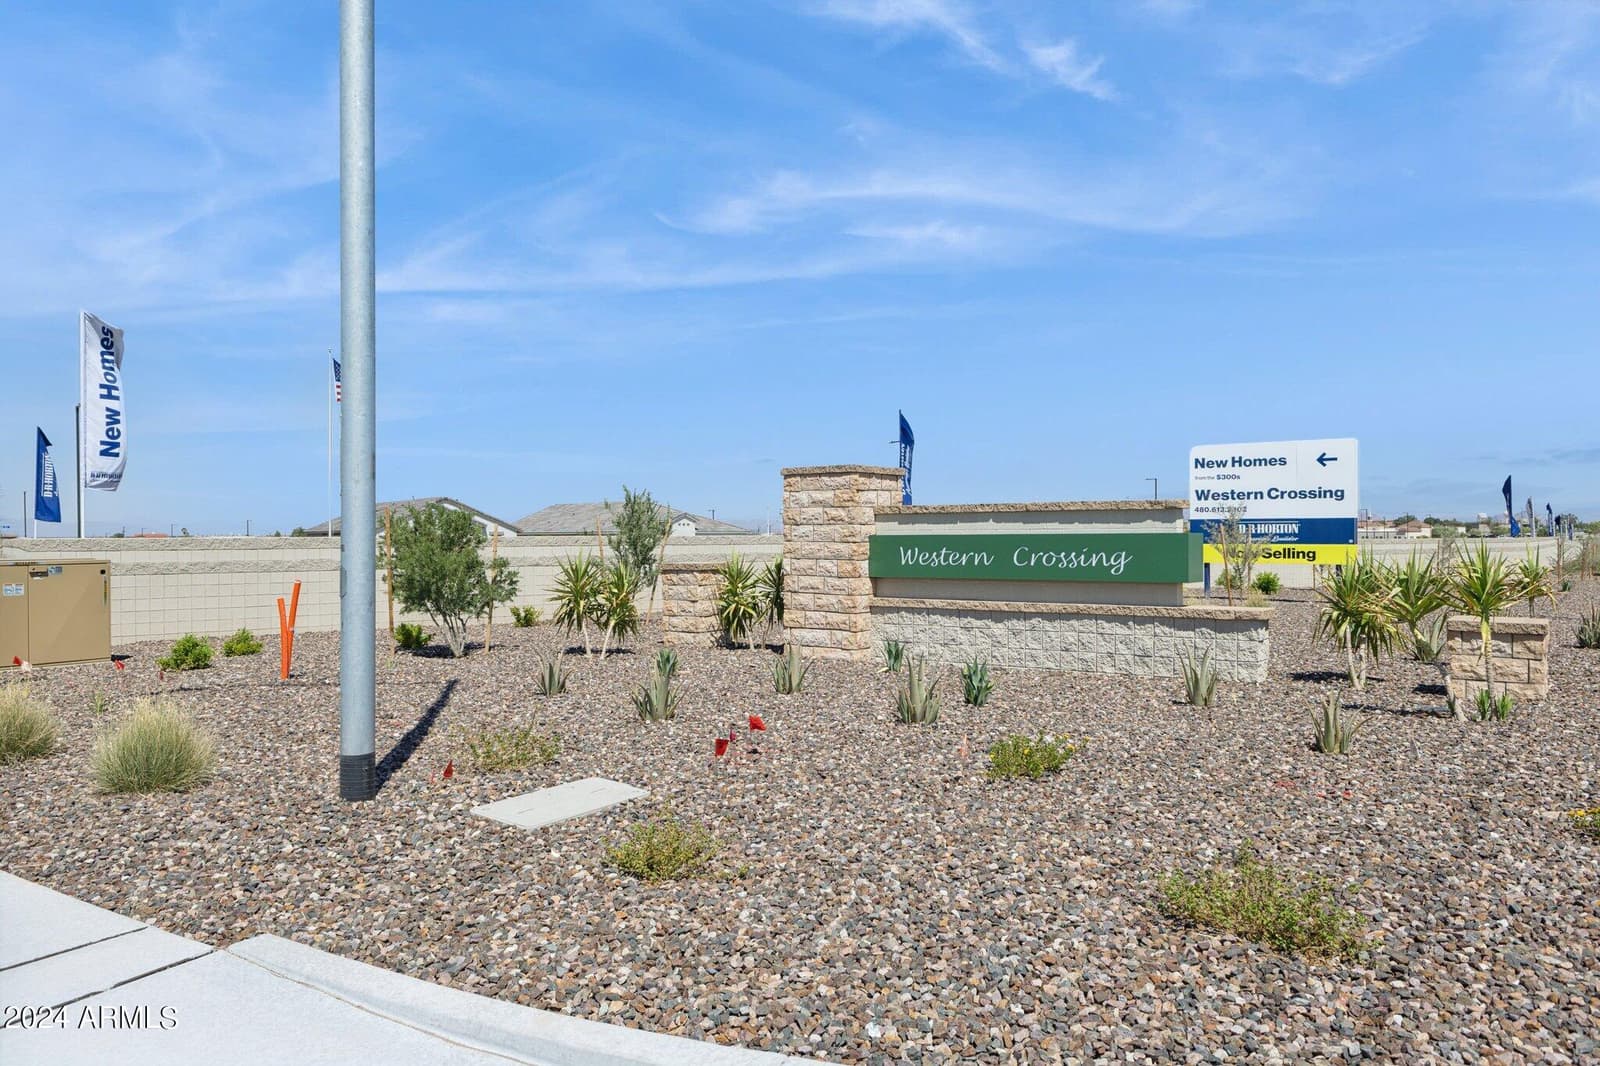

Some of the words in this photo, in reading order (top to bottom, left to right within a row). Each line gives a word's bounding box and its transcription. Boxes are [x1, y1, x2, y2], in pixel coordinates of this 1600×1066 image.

[99, 326, 120, 401] Homes
[100, 407, 121, 458] New
[1194, 458, 1229, 470] New
[1231, 456, 1288, 468] Homes
[1194, 488, 1264, 502] Western
[1266, 486, 1346, 502] Crossing
[899, 545, 995, 568] Western
[1013, 545, 1134, 576] Crossing
[1261, 547, 1317, 562] Selling
